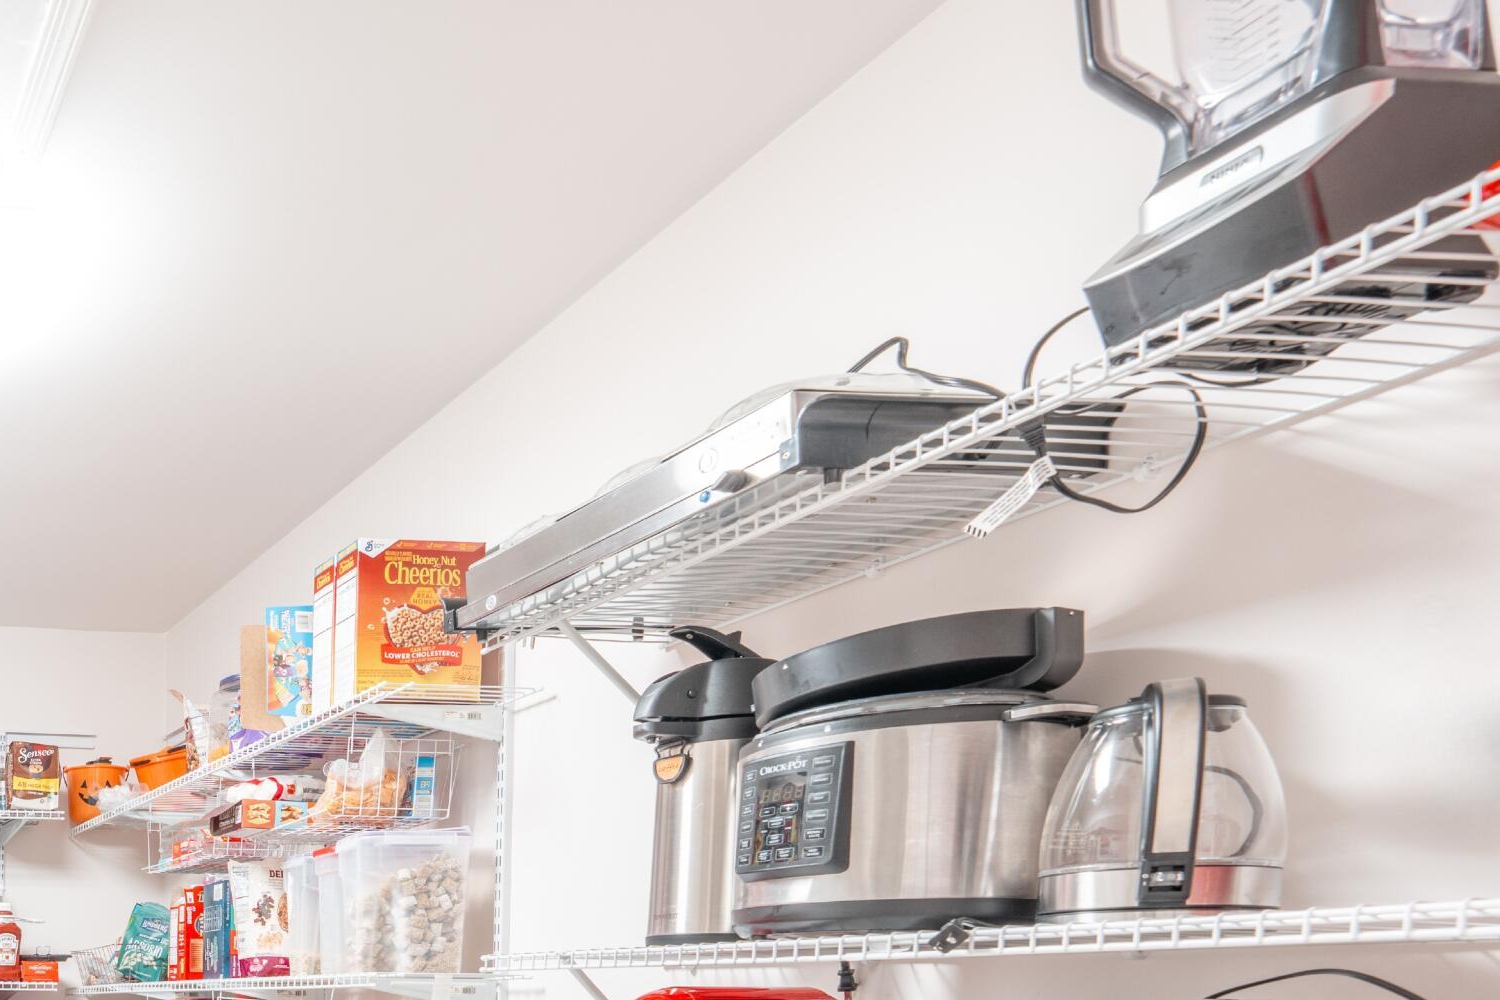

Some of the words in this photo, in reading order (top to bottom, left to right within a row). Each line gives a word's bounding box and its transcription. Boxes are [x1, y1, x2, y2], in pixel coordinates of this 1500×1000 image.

[412, 555, 439, 566] Honey
[441, 556, 457, 565] Nut
[384, 561, 461, 586] Cheerios
[384, 652, 411, 660] LOWER
[411, 650, 460, 659] CHOLESTEROL
[17, 747, 55, 763] Senseo
